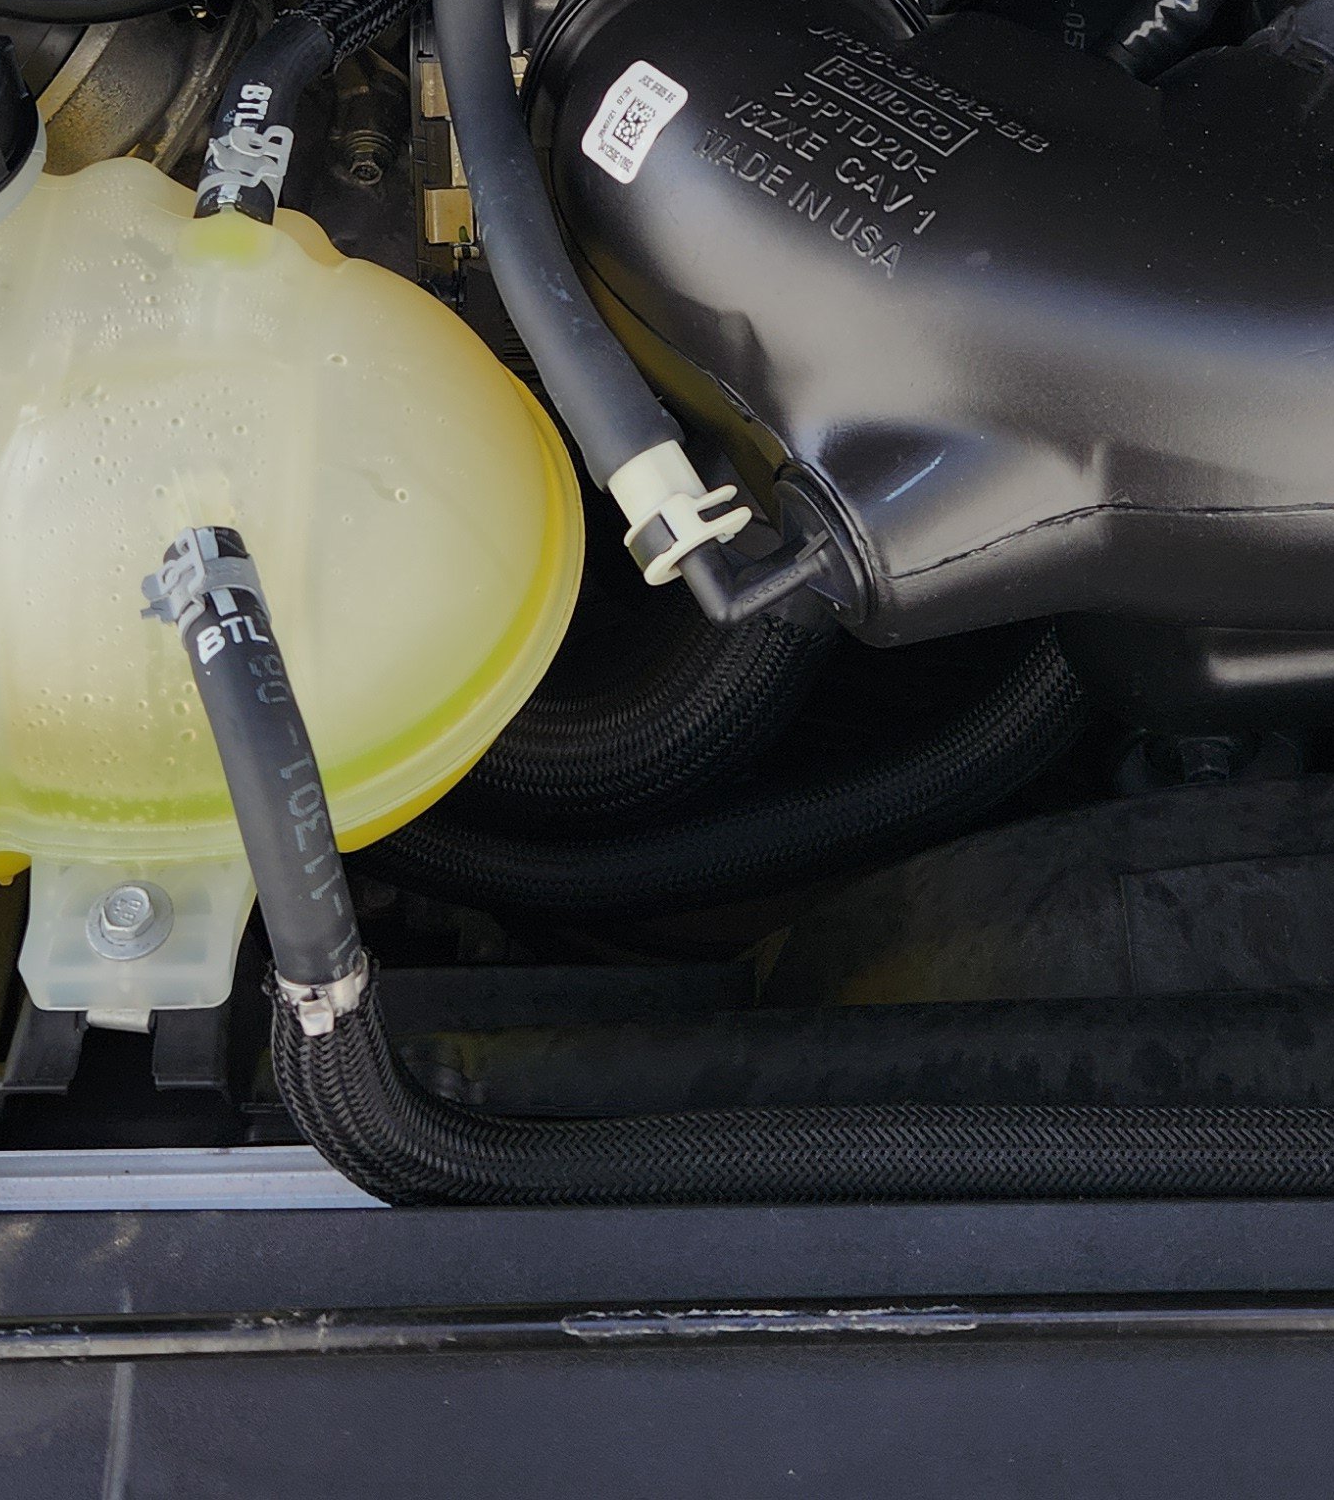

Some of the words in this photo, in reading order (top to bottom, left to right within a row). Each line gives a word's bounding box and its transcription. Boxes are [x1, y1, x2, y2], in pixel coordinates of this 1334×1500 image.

[696, 127, 793, 198] MADE
[787, 181, 833, 223] IN
[829, 207, 904, 280] USA
[834, 156, 915, 213] CAV
[913, 209, 937, 235] 1
[195, 615, 270, 665] BTL
